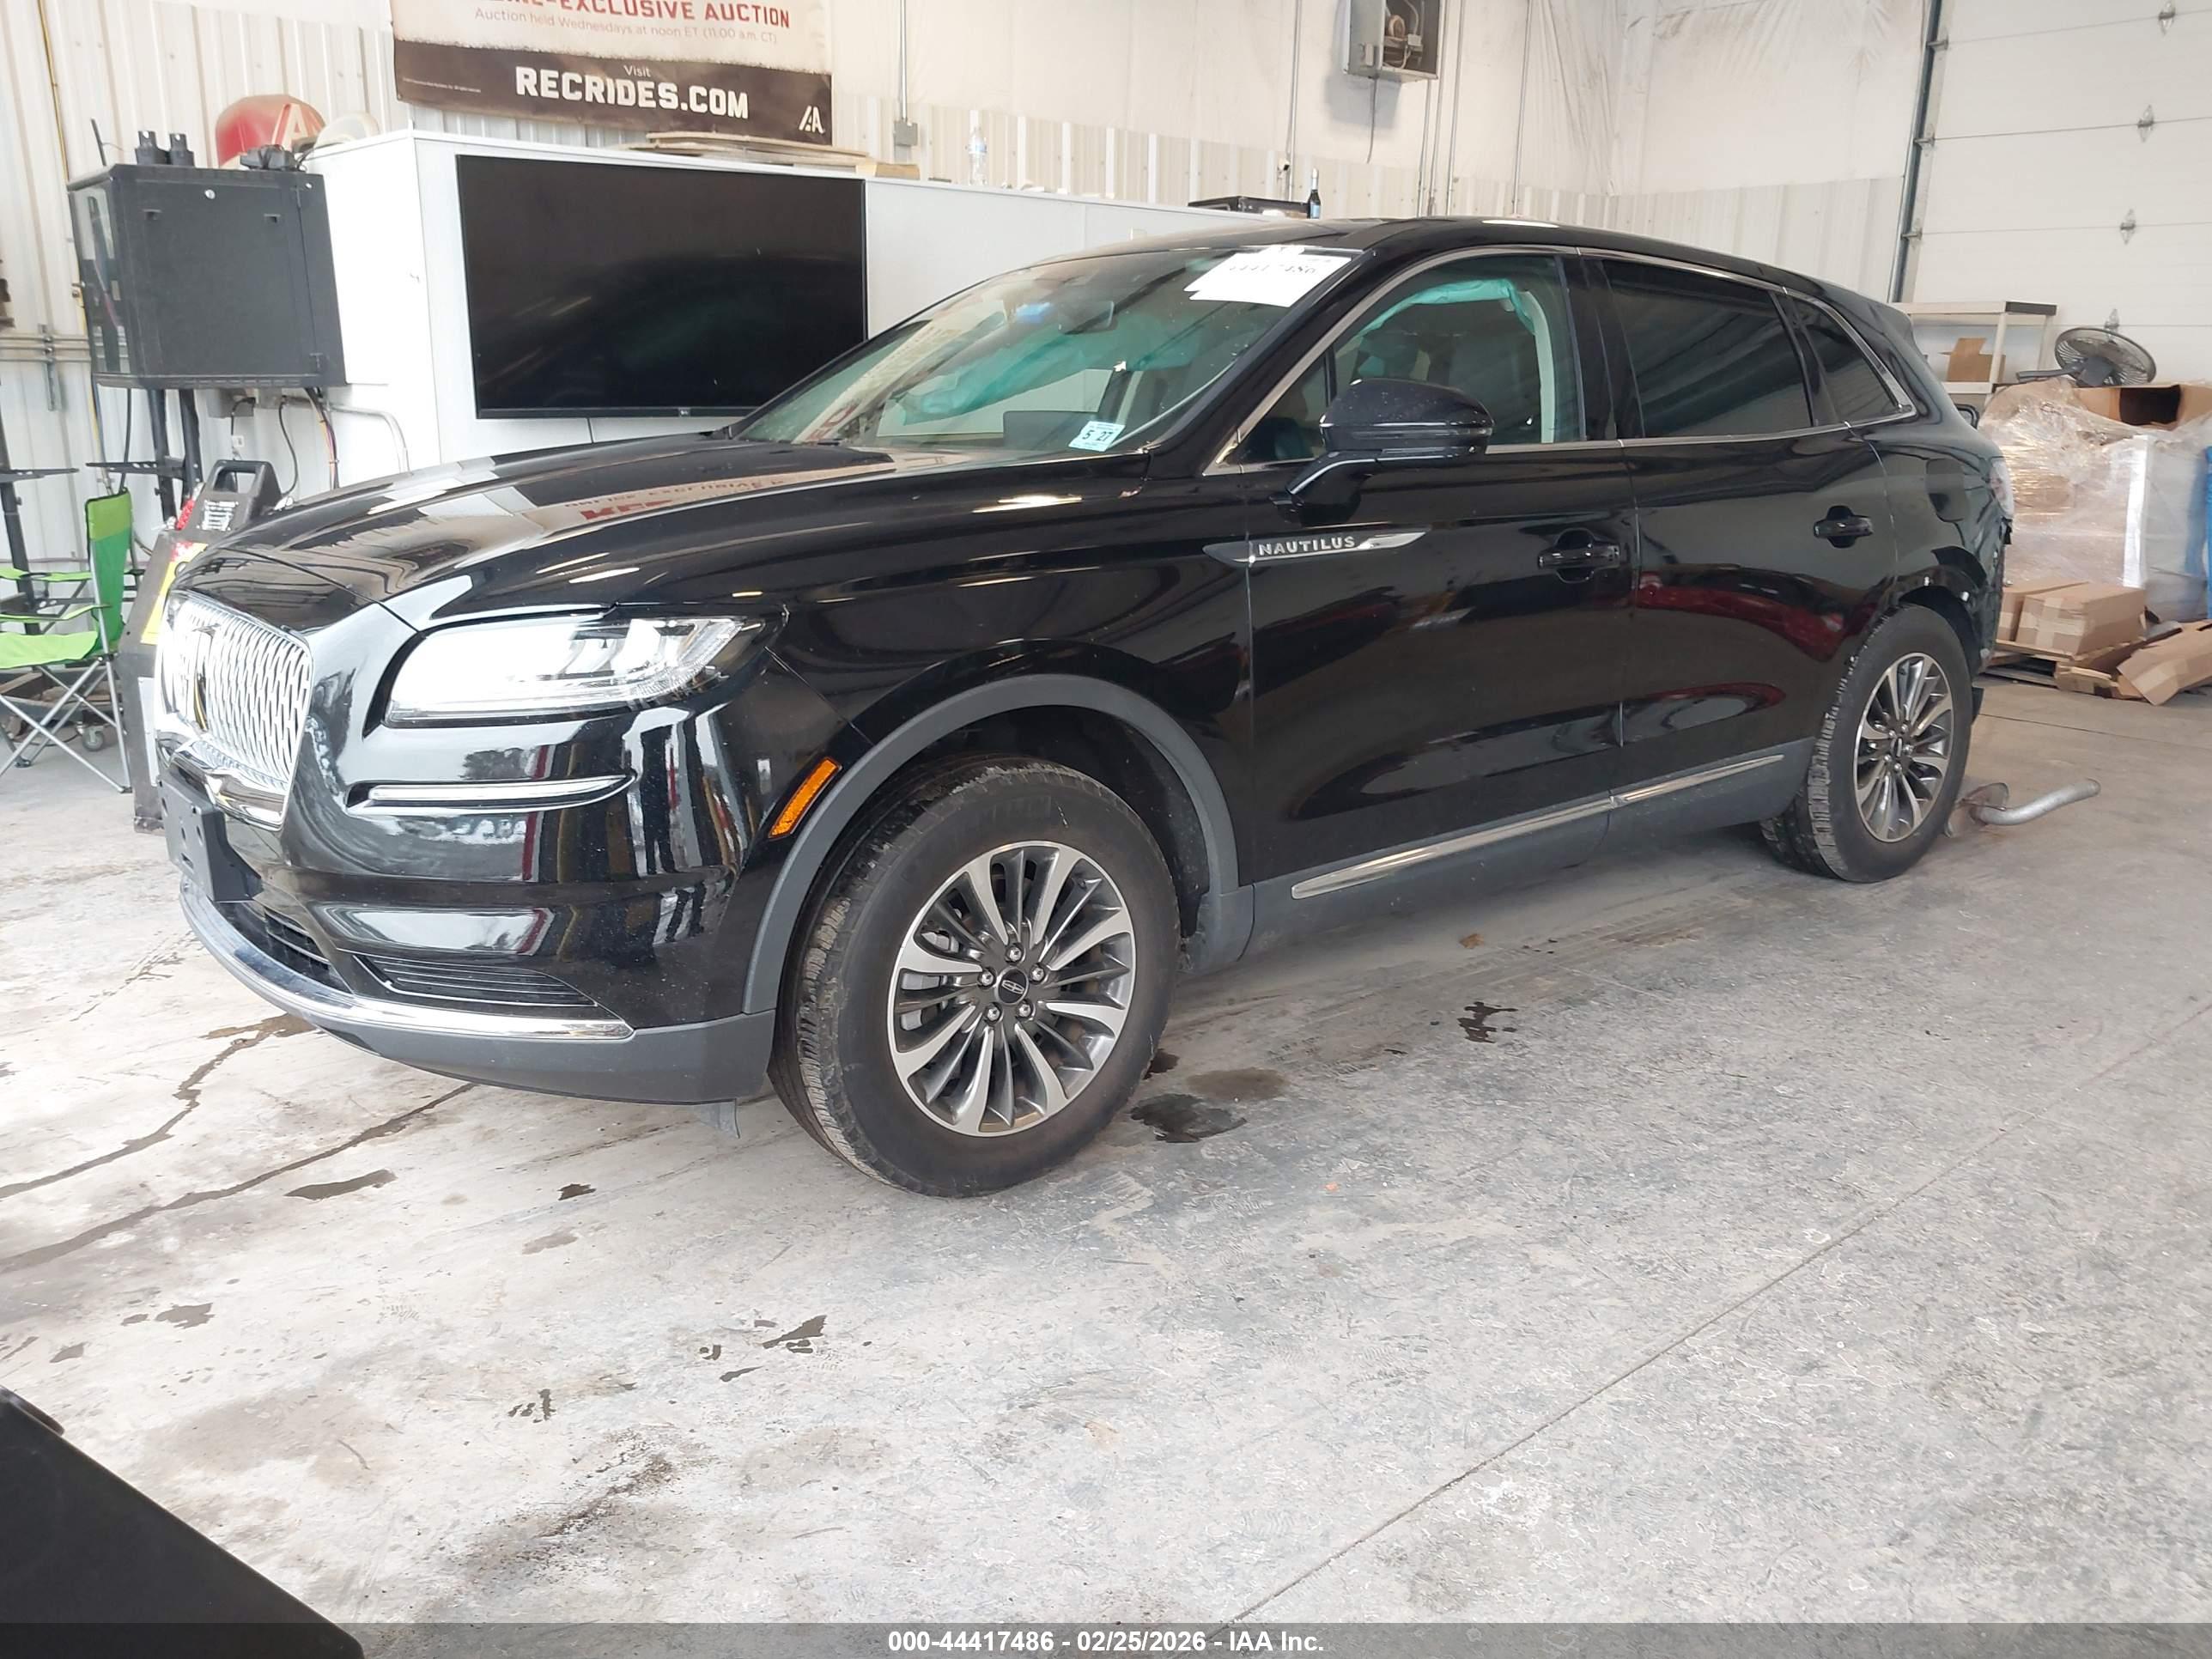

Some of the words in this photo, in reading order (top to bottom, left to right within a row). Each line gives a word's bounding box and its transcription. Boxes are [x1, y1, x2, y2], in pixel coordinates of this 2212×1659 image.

[475, 7, 527, 21] Auction
[529, 13, 556, 27] held
[558, 16, 633, 35] Wednesdays
[636, 25, 647, 35] at
[651, 27, 680, 37] noon
[684, 26, 699, 36] ET
[705, 3, 790, 28] AUCTION
[623, 64, 651, 77] Visit
[515, 65, 750, 119] RECRIDES.COM
[1082, 429, 1096, 440] 5
[1096, 431, 1115, 441] 27
[1258, 536, 1356, 556] NAUTILUS
